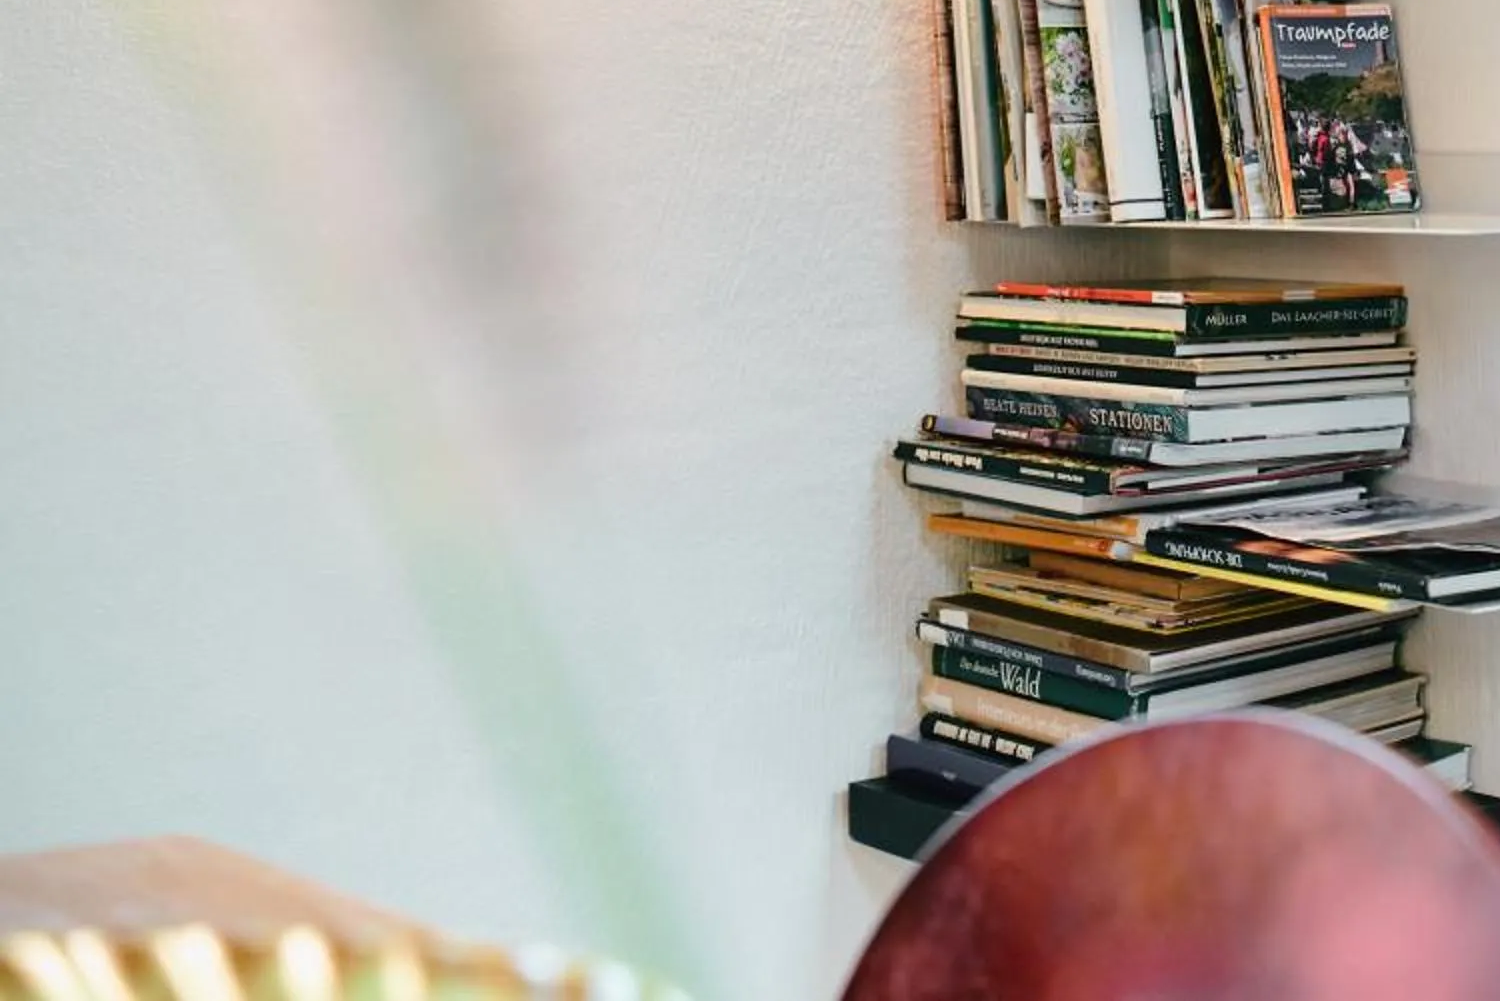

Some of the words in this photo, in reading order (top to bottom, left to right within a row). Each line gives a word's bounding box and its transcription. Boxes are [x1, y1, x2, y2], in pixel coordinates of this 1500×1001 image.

[1277, 22, 1390, 47] Traumpfade
[1089, 408, 1173, 434] STATIONEN
[1000, 662, 1041, 699] Wald
